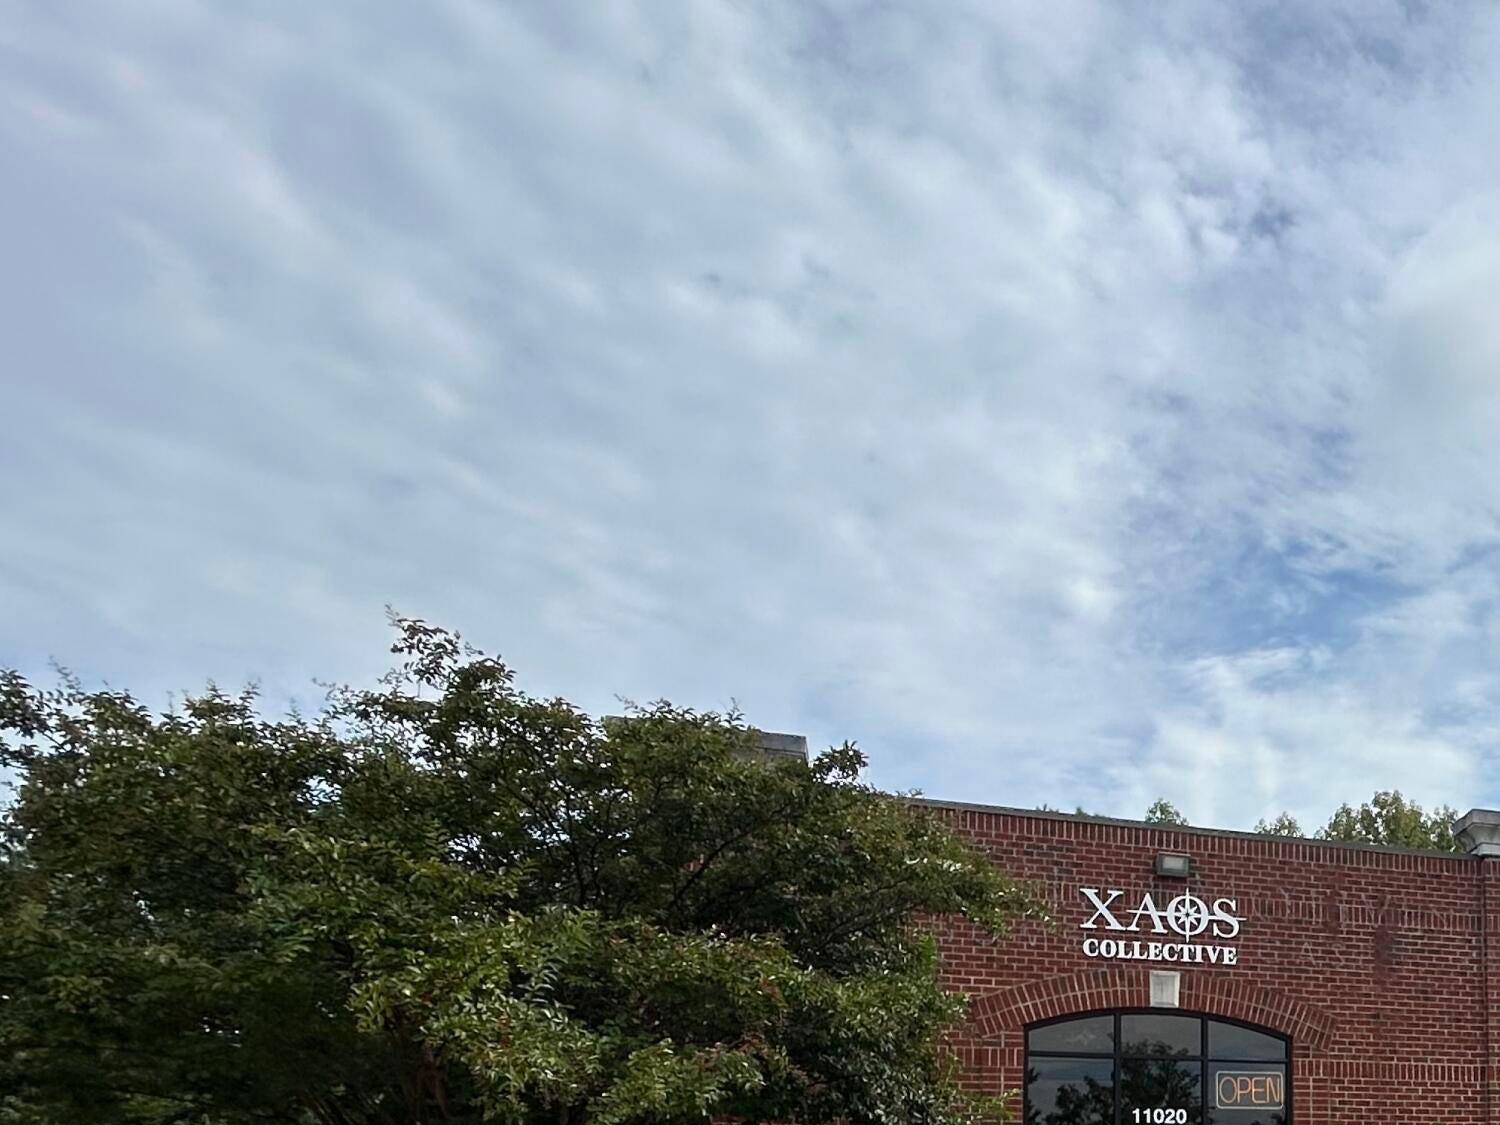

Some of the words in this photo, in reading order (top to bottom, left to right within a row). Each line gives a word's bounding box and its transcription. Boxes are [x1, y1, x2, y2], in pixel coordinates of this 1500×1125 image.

[1079, 888, 1247, 943] XAOS
[1082, 938, 1238, 965] COLLECTIVE
[1219, 1076, 1281, 1104] OPEN
[1132, 1108, 1187, 1124] 11020
